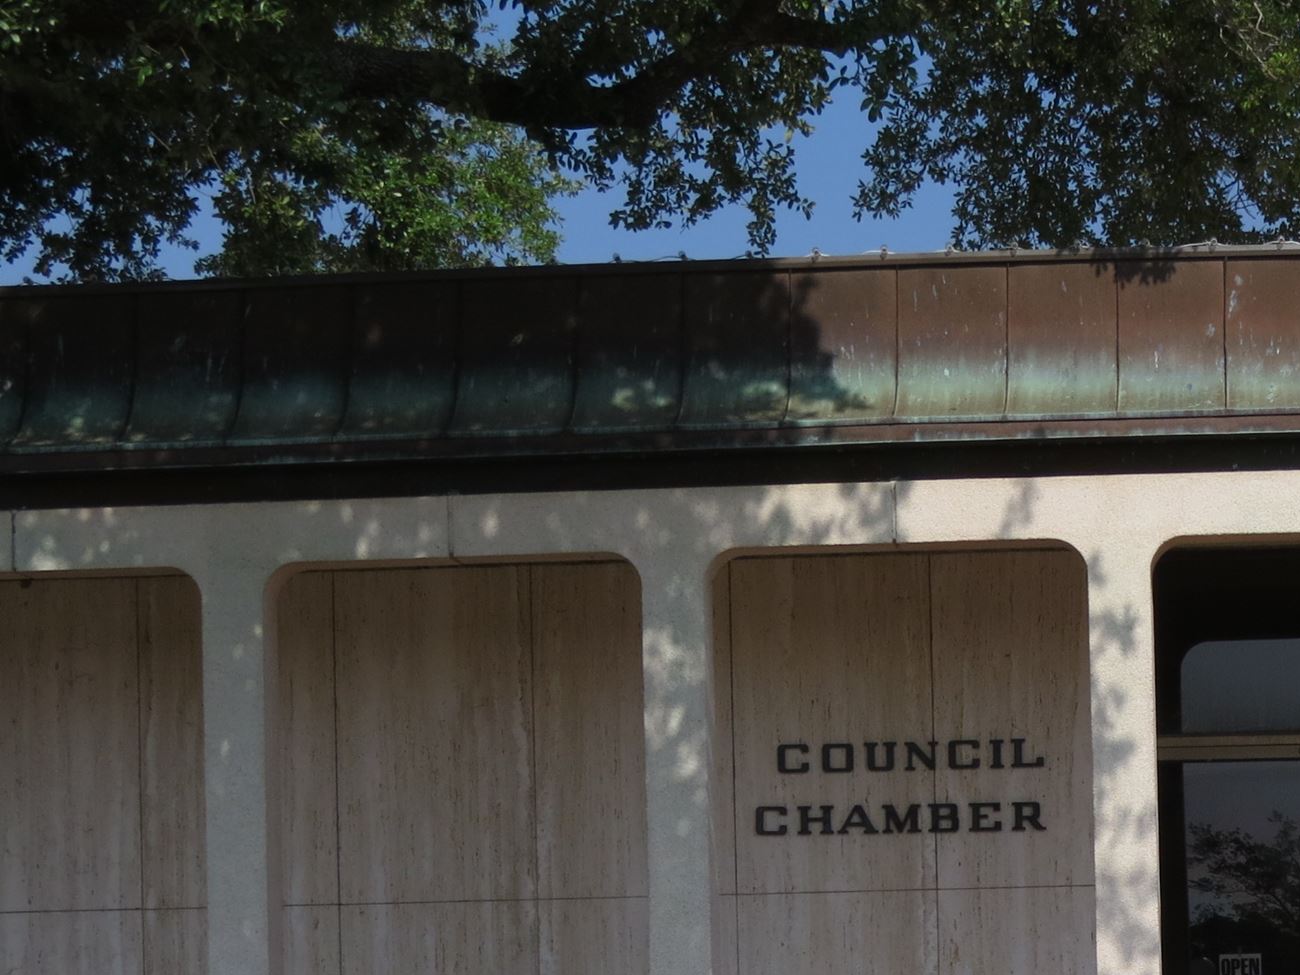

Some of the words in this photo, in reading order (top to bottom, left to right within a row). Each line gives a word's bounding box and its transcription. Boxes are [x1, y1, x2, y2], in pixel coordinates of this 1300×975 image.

[777, 738, 1045, 774] COUNCIL
[755, 801, 1047, 836] CHAMBER
[1221, 958, 1260, 975] OPEN
